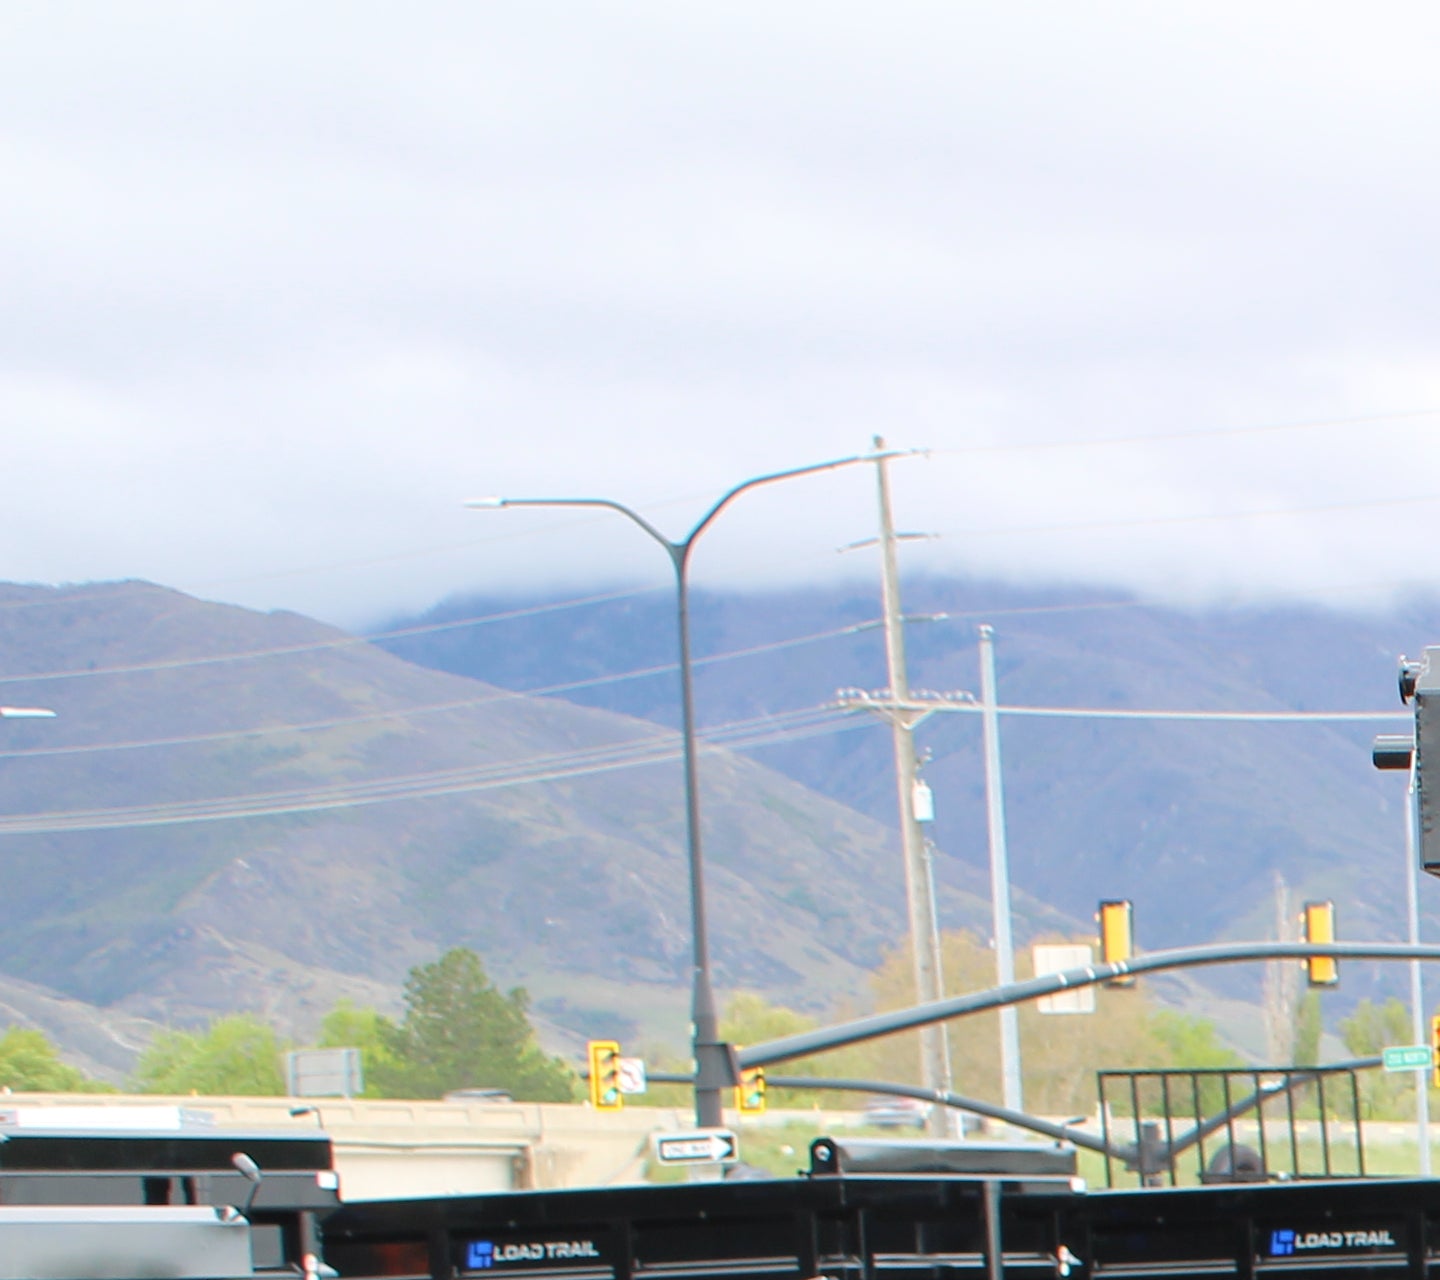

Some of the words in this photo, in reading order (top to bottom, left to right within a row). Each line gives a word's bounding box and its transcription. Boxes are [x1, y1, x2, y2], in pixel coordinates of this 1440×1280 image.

[1295, 1232, 1343, 1249] LOAD
[1343, 1229, 1396, 1247] TRAIL
[493, 1243, 545, 1262] LOAD
[544, 1240, 600, 1259] TRAIL
